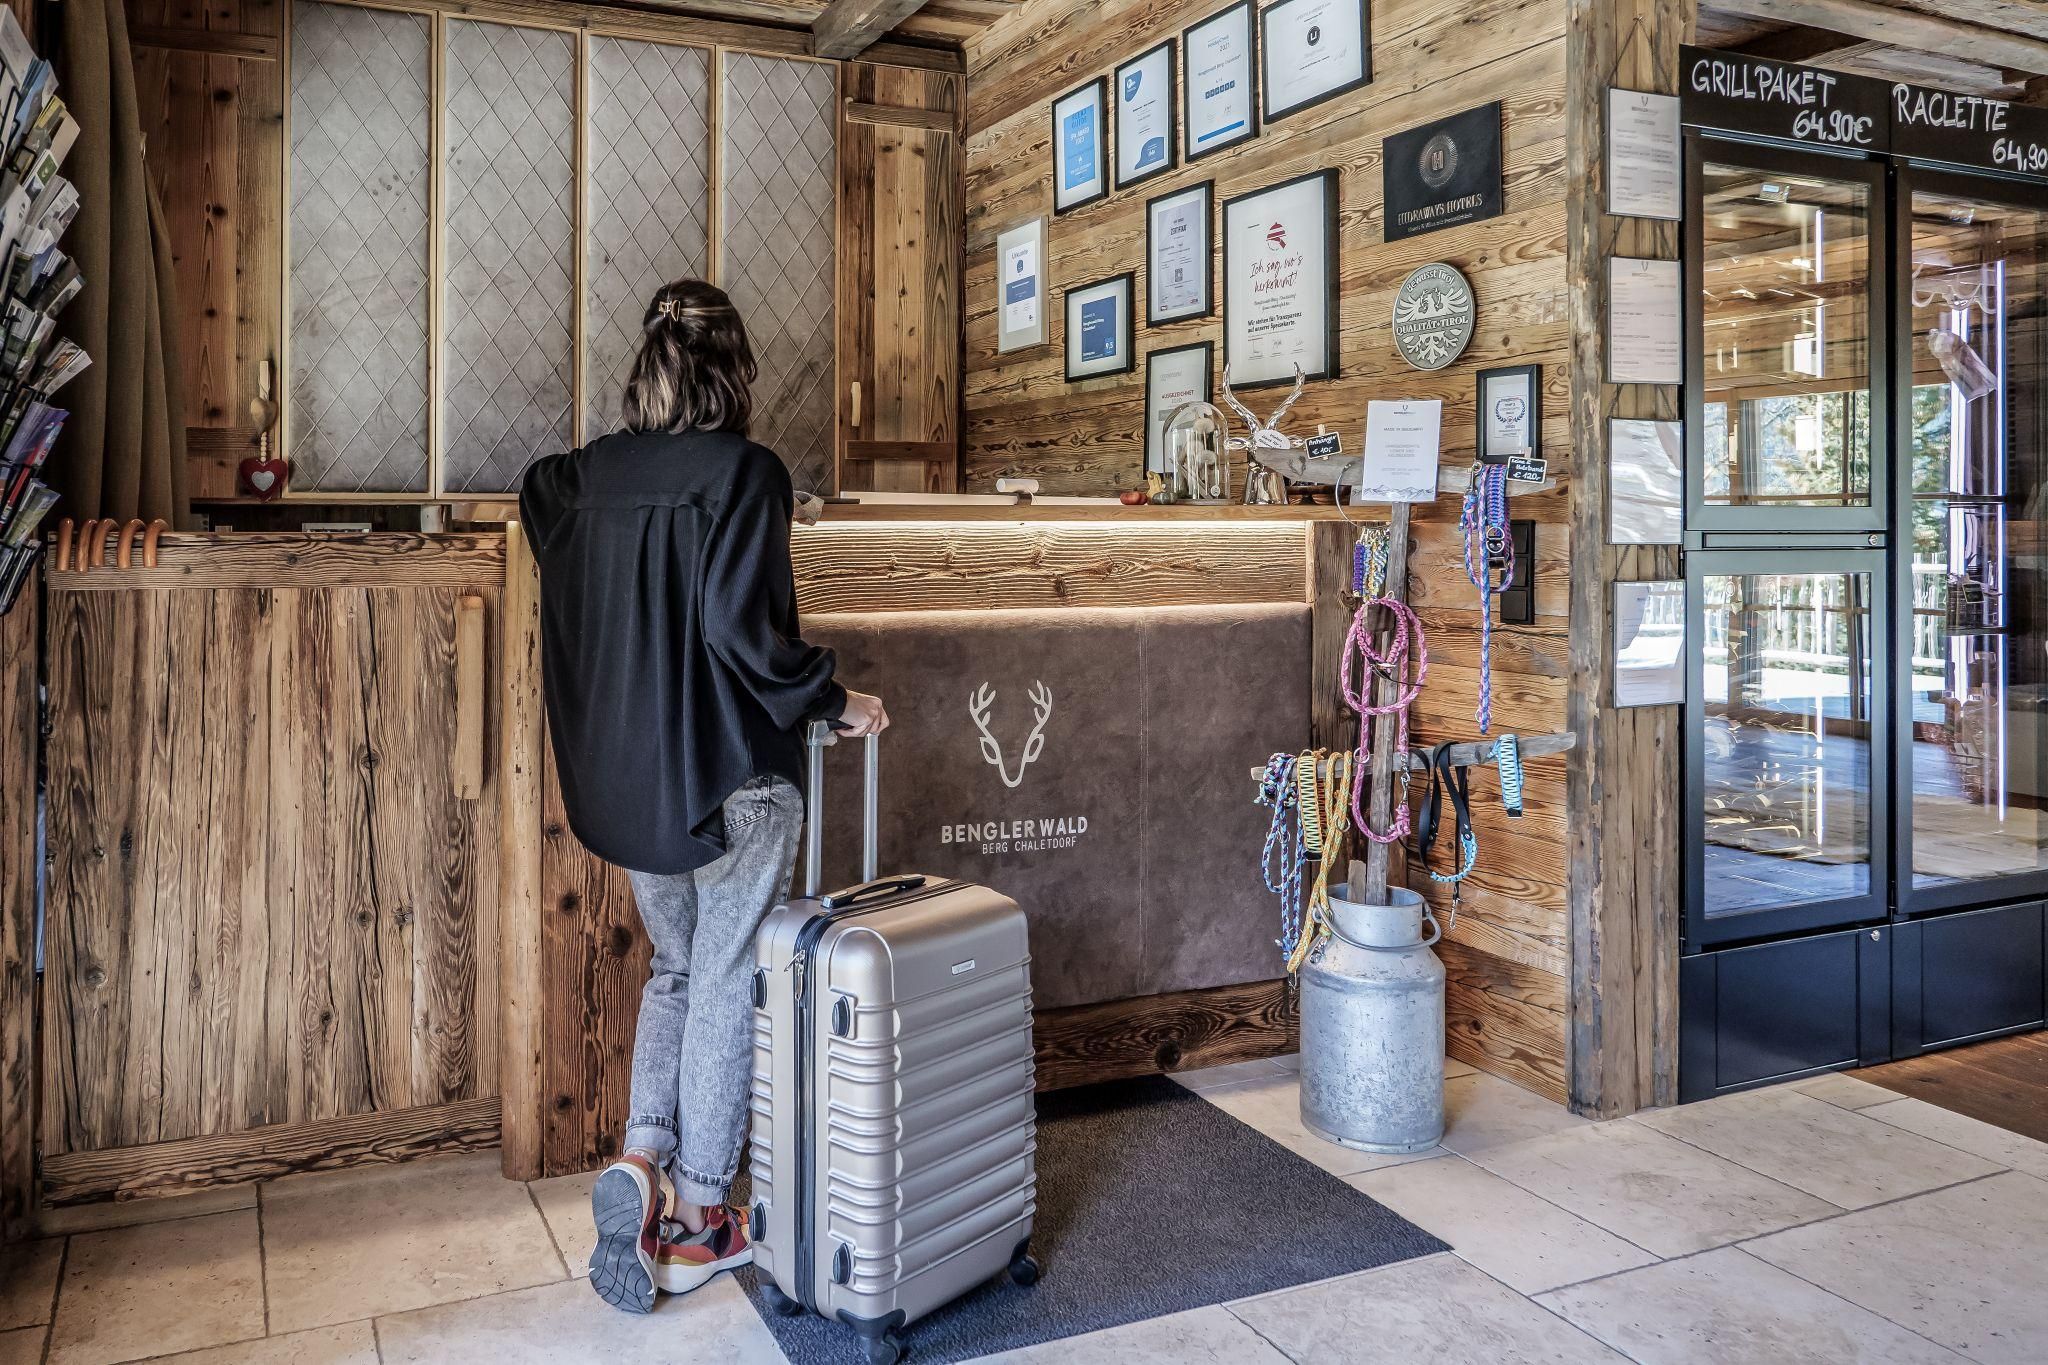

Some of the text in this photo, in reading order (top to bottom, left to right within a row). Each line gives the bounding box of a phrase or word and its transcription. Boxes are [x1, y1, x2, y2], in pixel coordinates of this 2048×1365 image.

[1893, 83, 2009, 132] RACLETTE
[1406, 269, 1455, 293] Bewusst Tirol
[982, 835, 1077, 855] BERG CHALETDORF
